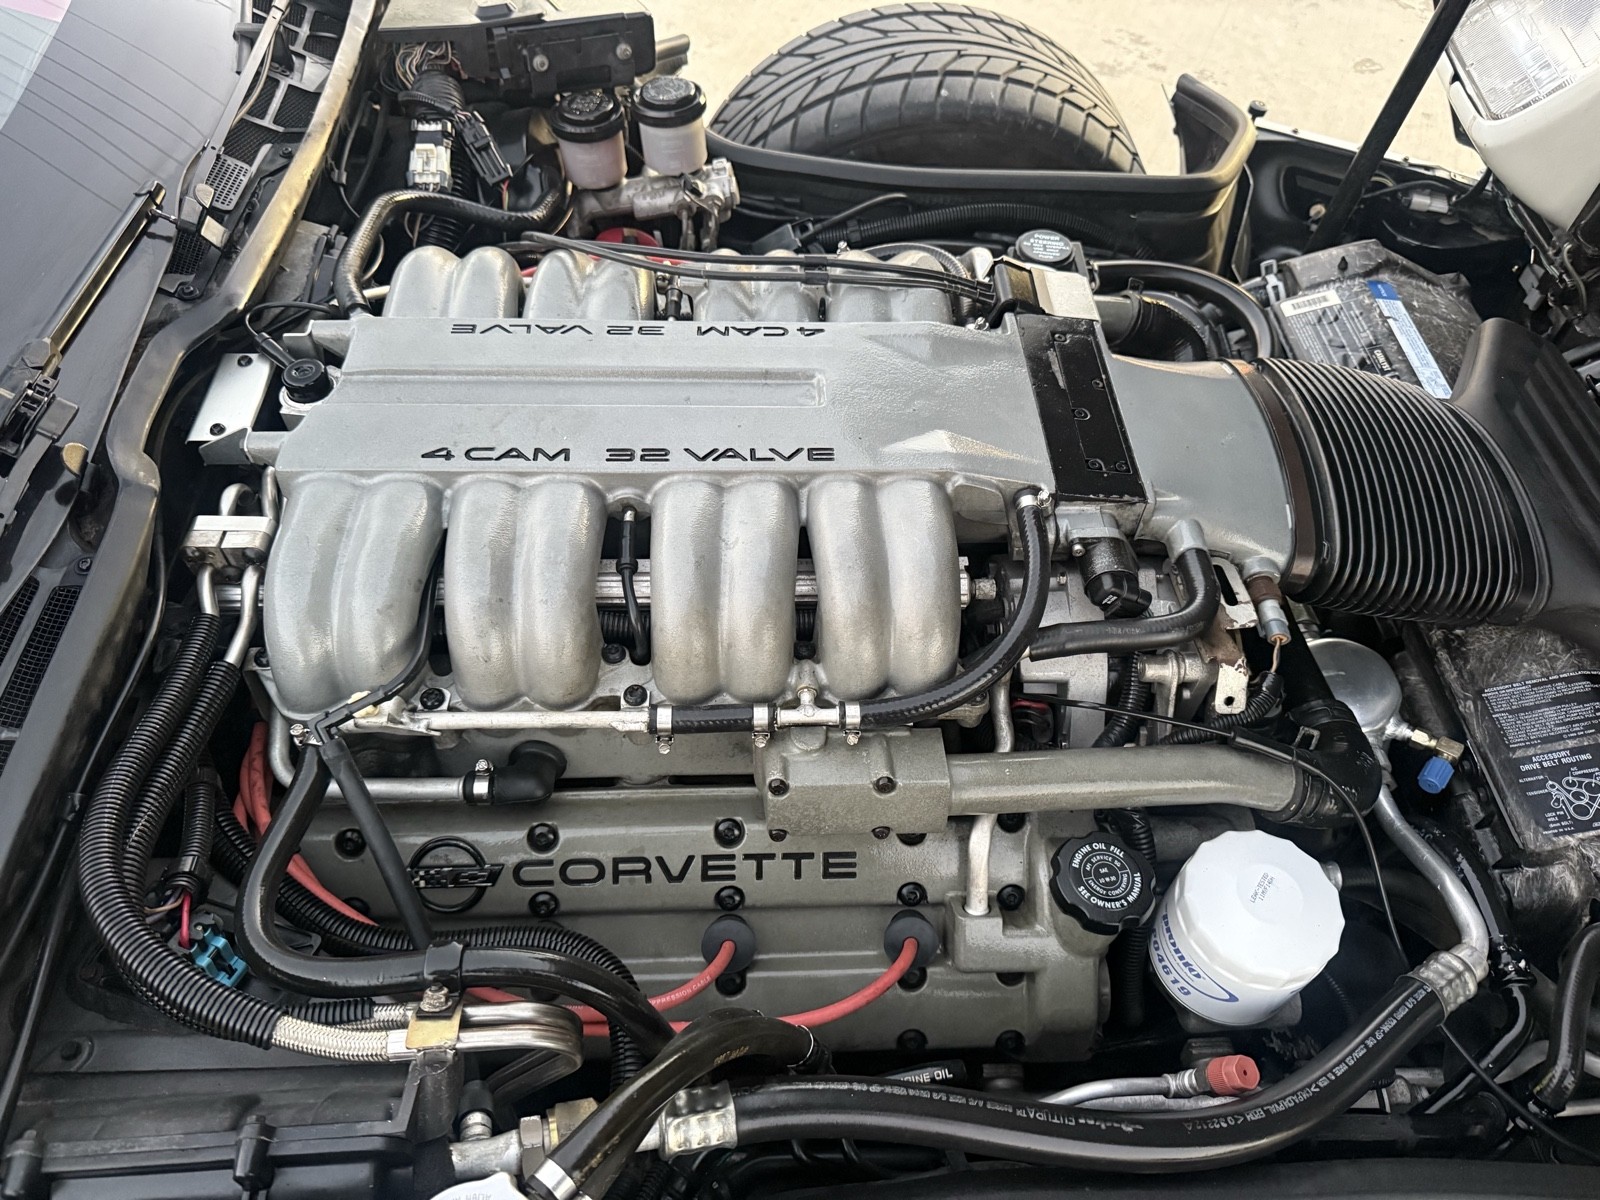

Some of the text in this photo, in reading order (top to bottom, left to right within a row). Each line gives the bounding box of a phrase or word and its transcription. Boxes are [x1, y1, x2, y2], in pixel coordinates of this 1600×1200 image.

[1030, 238, 1064, 246] STEERING
[451, 323, 826, 338] 4 CAM 32 VALVE
[421, 446, 835, 462] 4 CAM 32 VALVE
[1520, 753, 1592, 772] DRIVE BELT ROUTING
[1532, 750, 1570, 762] ACCESSORY
[1572, 767, 1600, 775] COMPRESSOR
[1072, 844, 1091, 868] ENGINE
[1110, 845, 1124, 858] FILL
[512, 850, 858, 887] CORVETTE
[1078, 872, 1142, 909] SEE OWNER'S MANUAL
[1088, 874, 1127, 895] ENERGY CONSERVING
[934, 1068, 953, 1080] OIL
